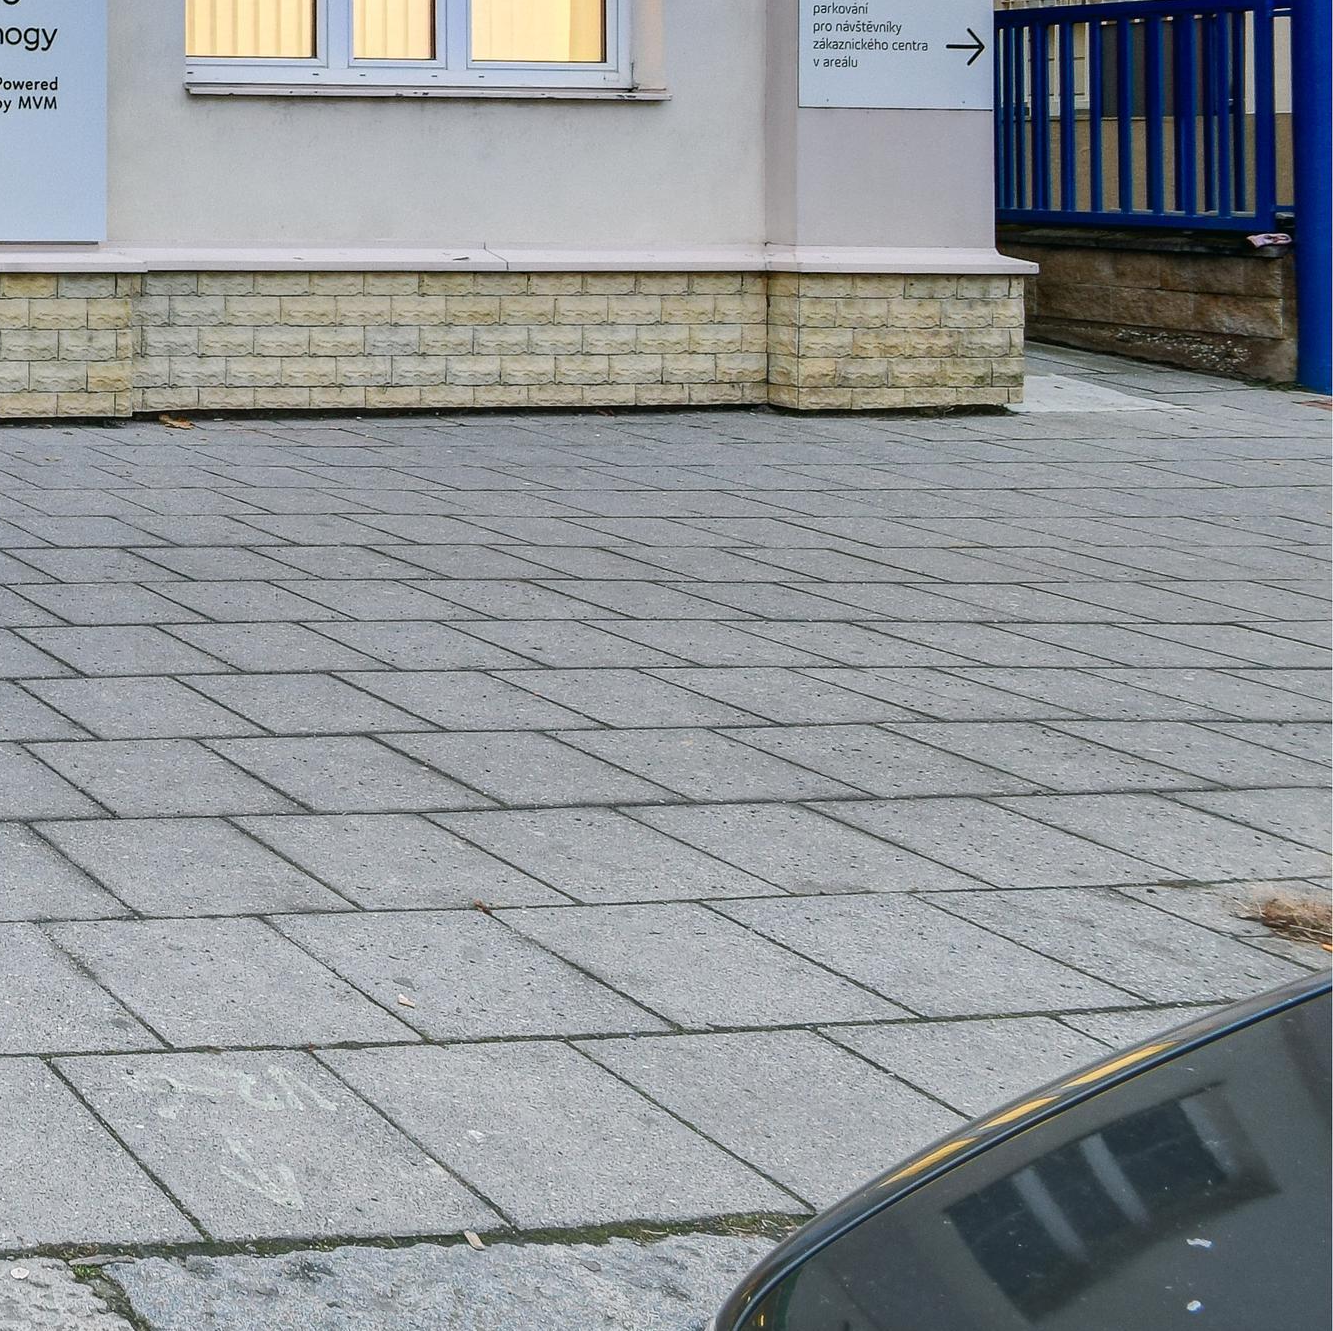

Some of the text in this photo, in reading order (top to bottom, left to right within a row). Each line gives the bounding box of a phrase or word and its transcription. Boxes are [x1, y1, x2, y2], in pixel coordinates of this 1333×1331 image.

[813, 2, 869, 16] parkování
[813, 20, 902, 36] pro návštěvníky
[813, 37, 929, 51] zákaznického centra
[813, 56, 858, 68] v areálu
[18, 95, 57, 109] MVM
